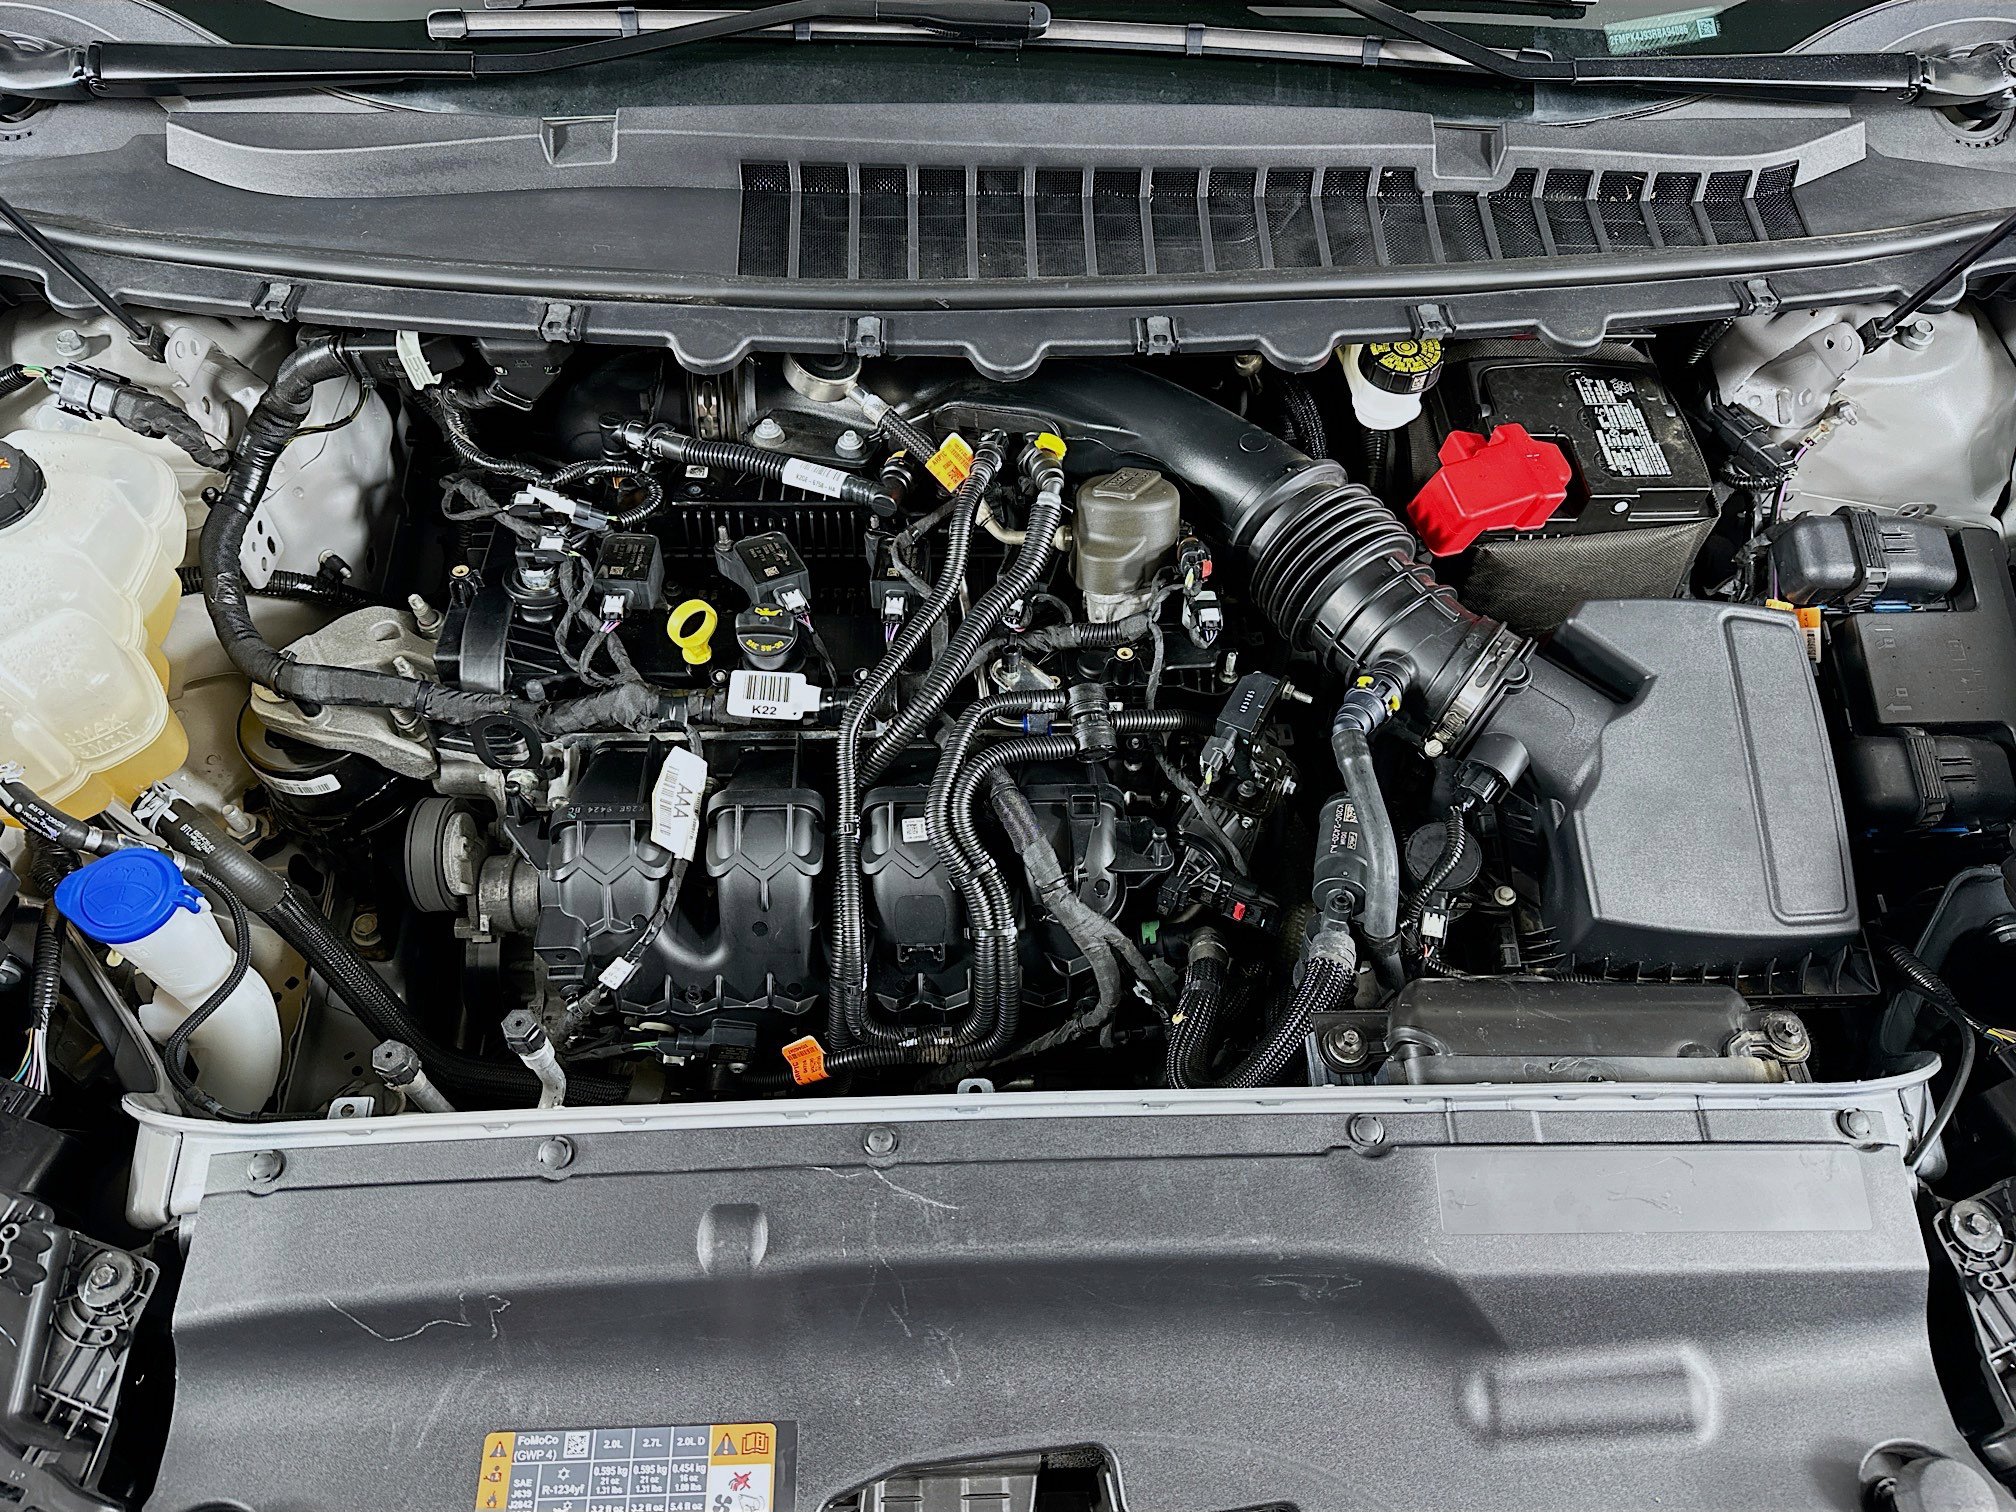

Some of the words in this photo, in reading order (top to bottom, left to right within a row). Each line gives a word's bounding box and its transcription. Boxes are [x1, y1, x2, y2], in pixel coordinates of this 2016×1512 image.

[745, 639, 760, 650] SAE
[752, 705, 777, 715] K22
[673, 782, 693, 819] AAA
[517, 1435, 559, 1446] FoMoCo
[603, 1439, 623, 1449] 2.0L
[642, 1438, 663, 1448] 2.7L
[676, 1437, 697, 1447] 2.0L
[698, 1436, 706, 1445] D
[513, 1450, 544, 1463] (GWP
[546, 1449, 557, 1462] 4)
[593, 1466, 616, 1476] 0.595
[617, 1466, 629, 1477] kg
[633, 1464, 656, 1475] 0.595
[656, 1464, 668, 1475] kg
[672, 1463, 695, 1474] 0.454
[695, 1463, 707, 1475] kg
[513, 1478, 533, 1488] SAE
[600, 1476, 610, 1485] 21
[639, 1475, 649, 1484] 21
[541, 1484, 585, 1496] R-1234yf
